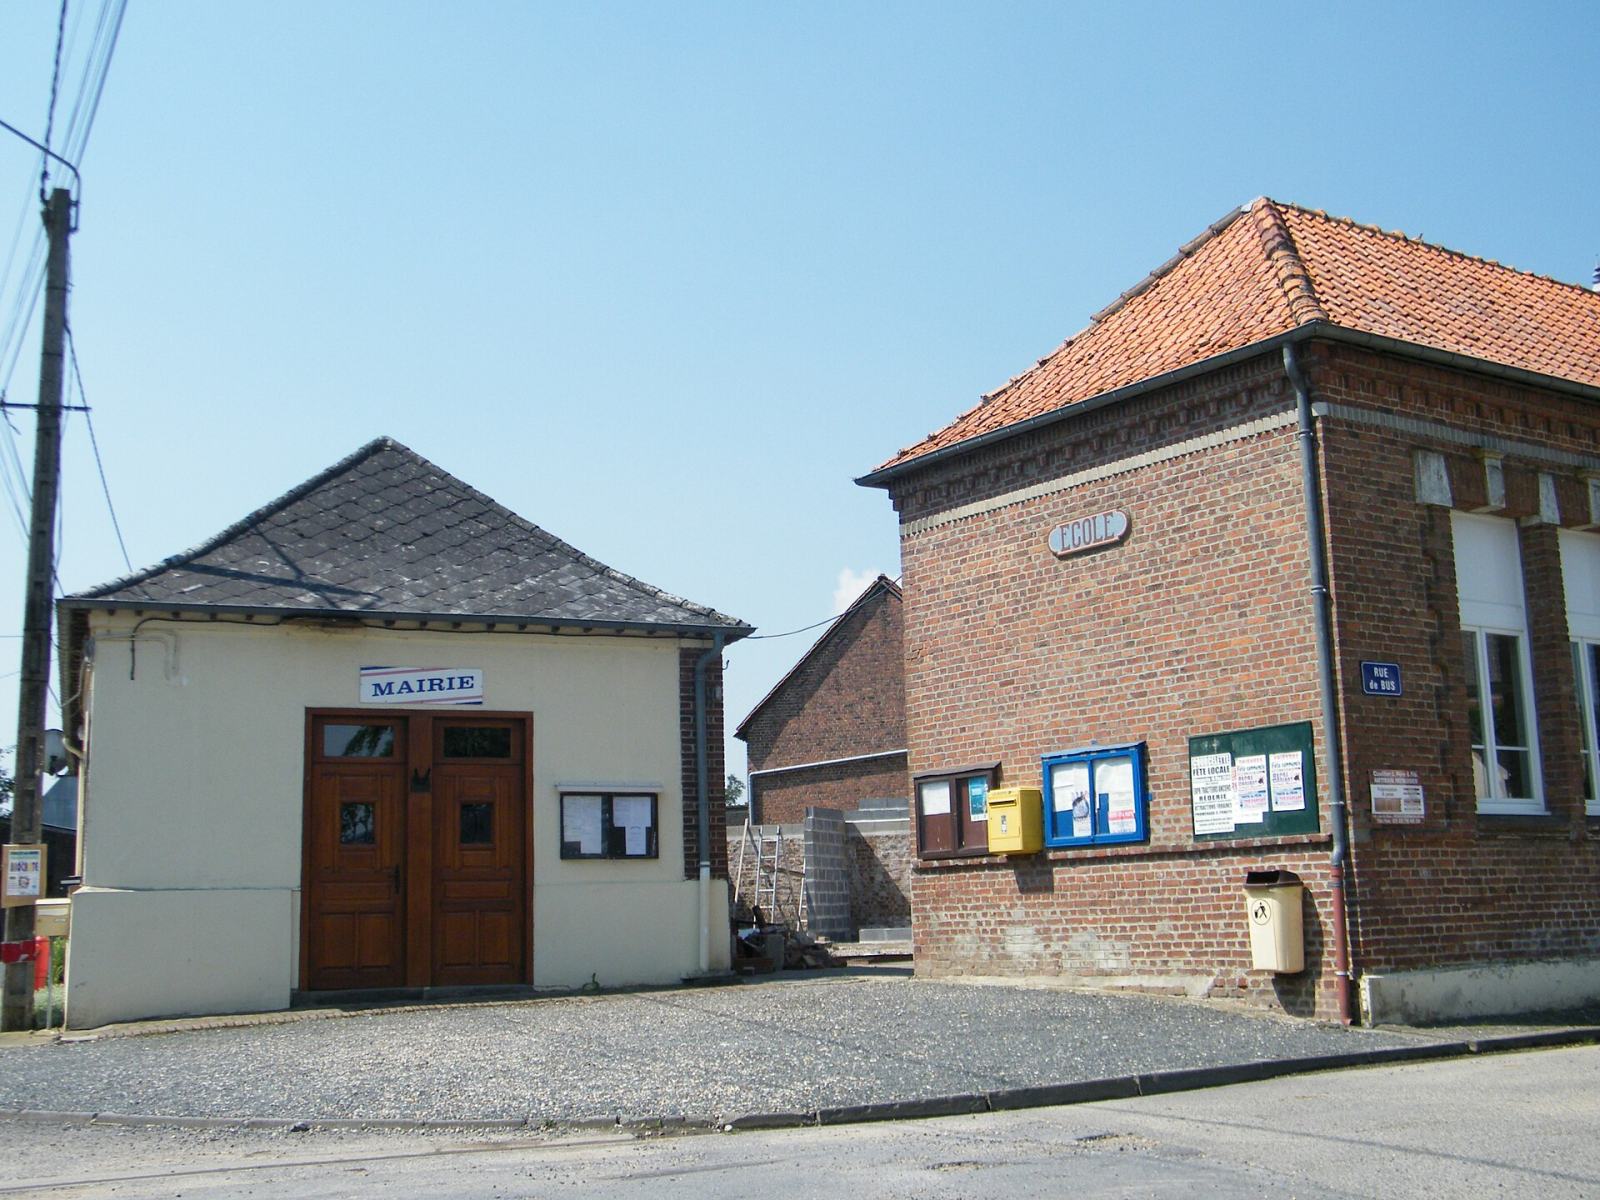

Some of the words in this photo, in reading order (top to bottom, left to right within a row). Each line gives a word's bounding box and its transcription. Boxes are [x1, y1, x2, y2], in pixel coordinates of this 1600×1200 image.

[1060, 512, 1115, 551] ECOLE
[1373, 666, 1389, 678] RUE
[371, 675, 475, 697] MAIRIE
[1369, 680, 1378, 690] de
[1380, 680, 1396, 691] BUS
[1207, 765, 1230, 775] LOCALE
